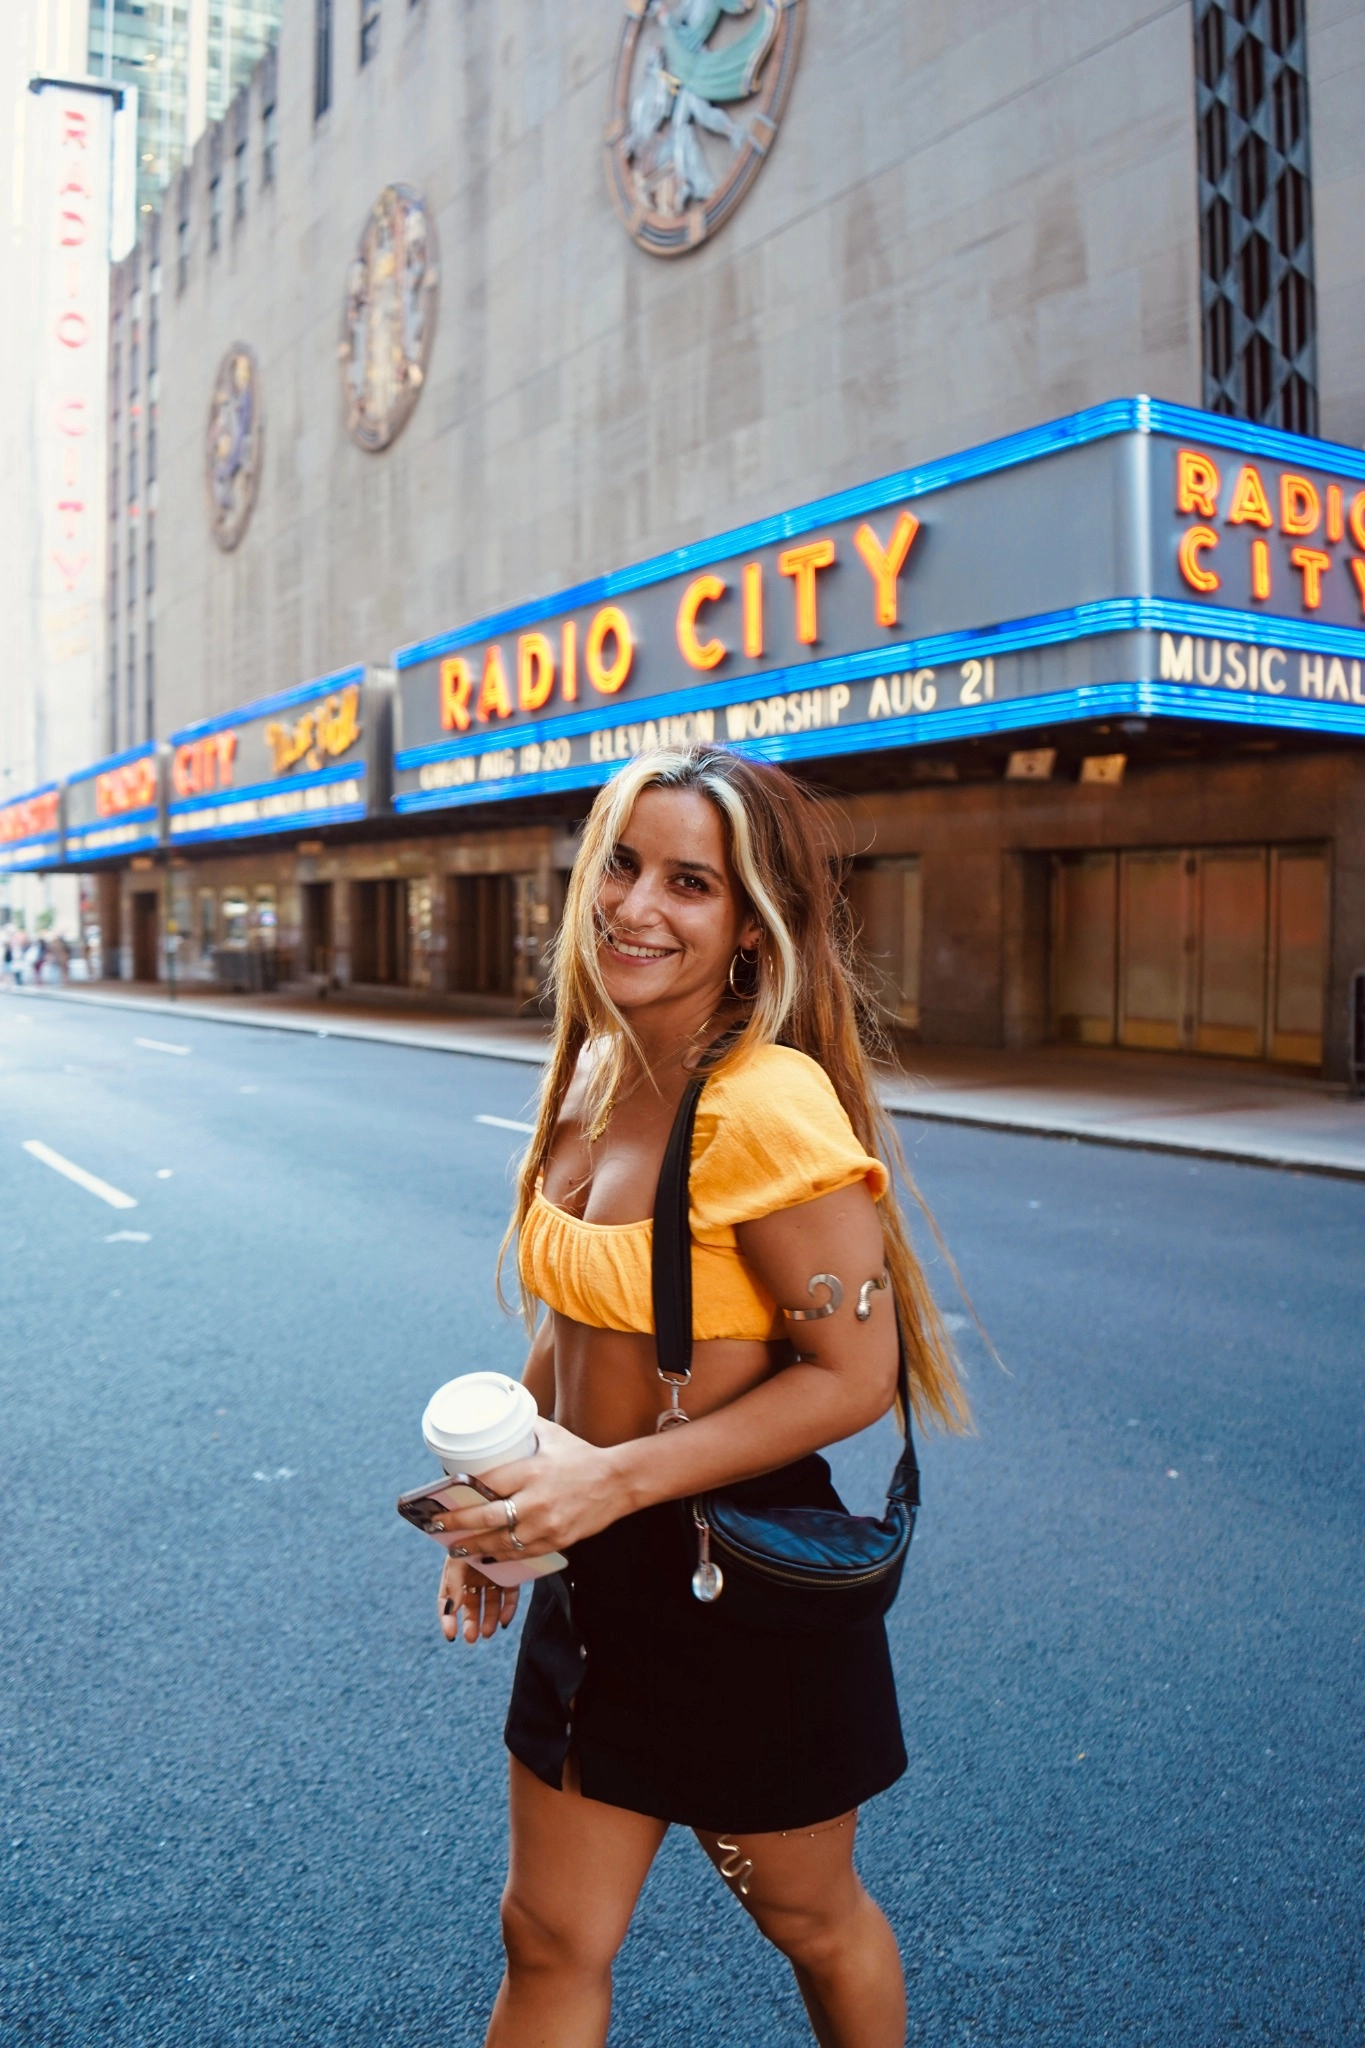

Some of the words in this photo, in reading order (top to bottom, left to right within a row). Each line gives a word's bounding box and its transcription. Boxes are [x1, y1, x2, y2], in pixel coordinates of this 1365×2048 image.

[57, 110, 90, 348] RADIO
[53, 401, 89, 591] CITY
[440, 606, 633, 731] RADIO
[676, 510, 920, 671] CITY
[1160, 631, 1287, 695] MUSIC
[172, 729, 238, 797] CITY
[478, 746, 516, 781] AUG
[726, 684, 851, 741] WORSHIP
[867, 667, 937, 720] AUG
[959, 658, 995, 706] 21
